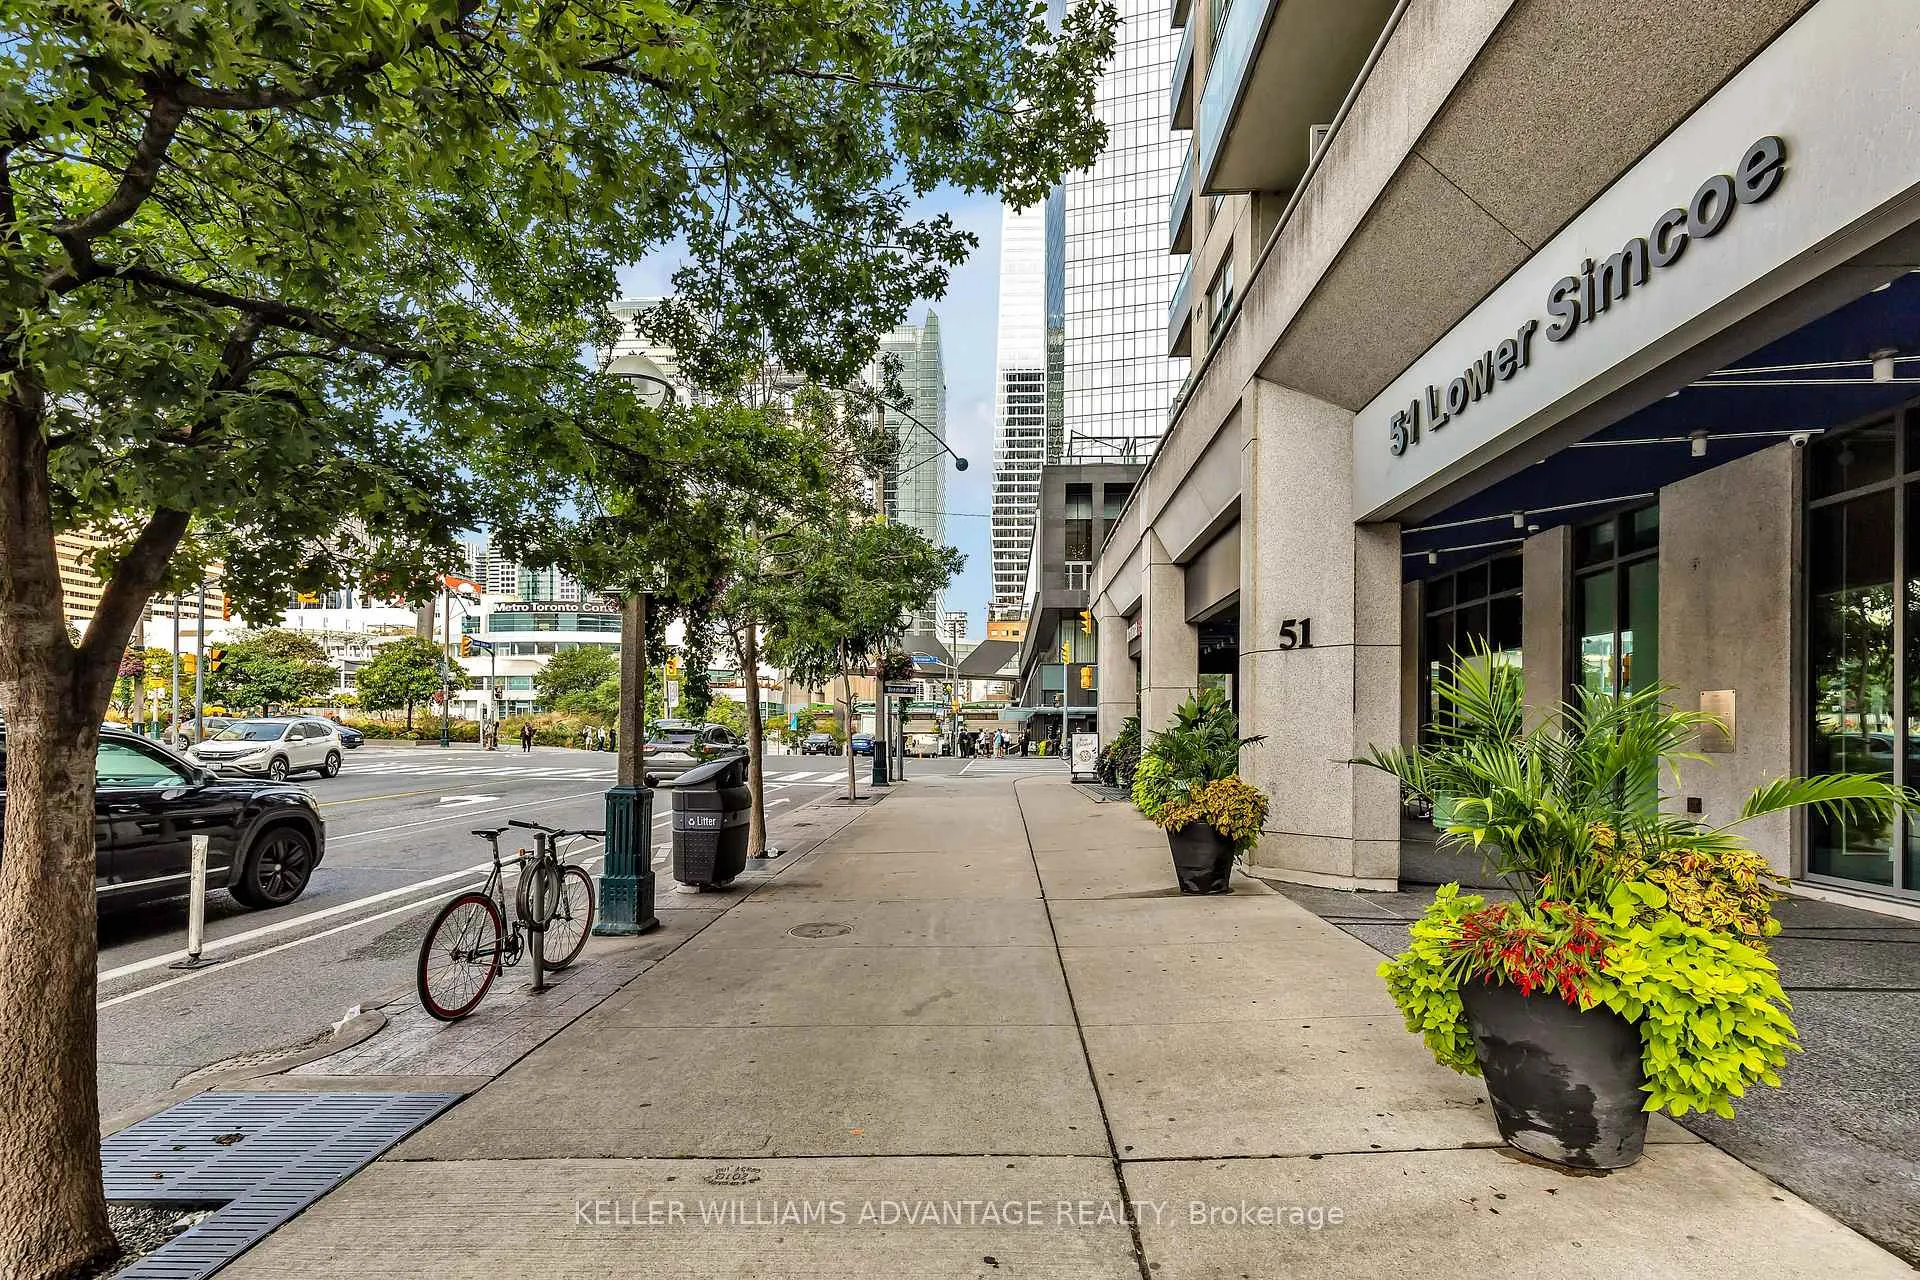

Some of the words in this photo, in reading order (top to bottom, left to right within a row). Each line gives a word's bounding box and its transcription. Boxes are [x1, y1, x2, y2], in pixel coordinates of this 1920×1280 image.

[1389, 399, 1420, 457] 51
[1424, 319, 1538, 432] Lower
[1545, 135, 1788, 342] Simcoe
[495, 602, 530, 612] Metro
[531, 602, 579, 612] Toronto
[1279, 617, 1314, 650] 51
[696, 816, 717, 827] Litter
